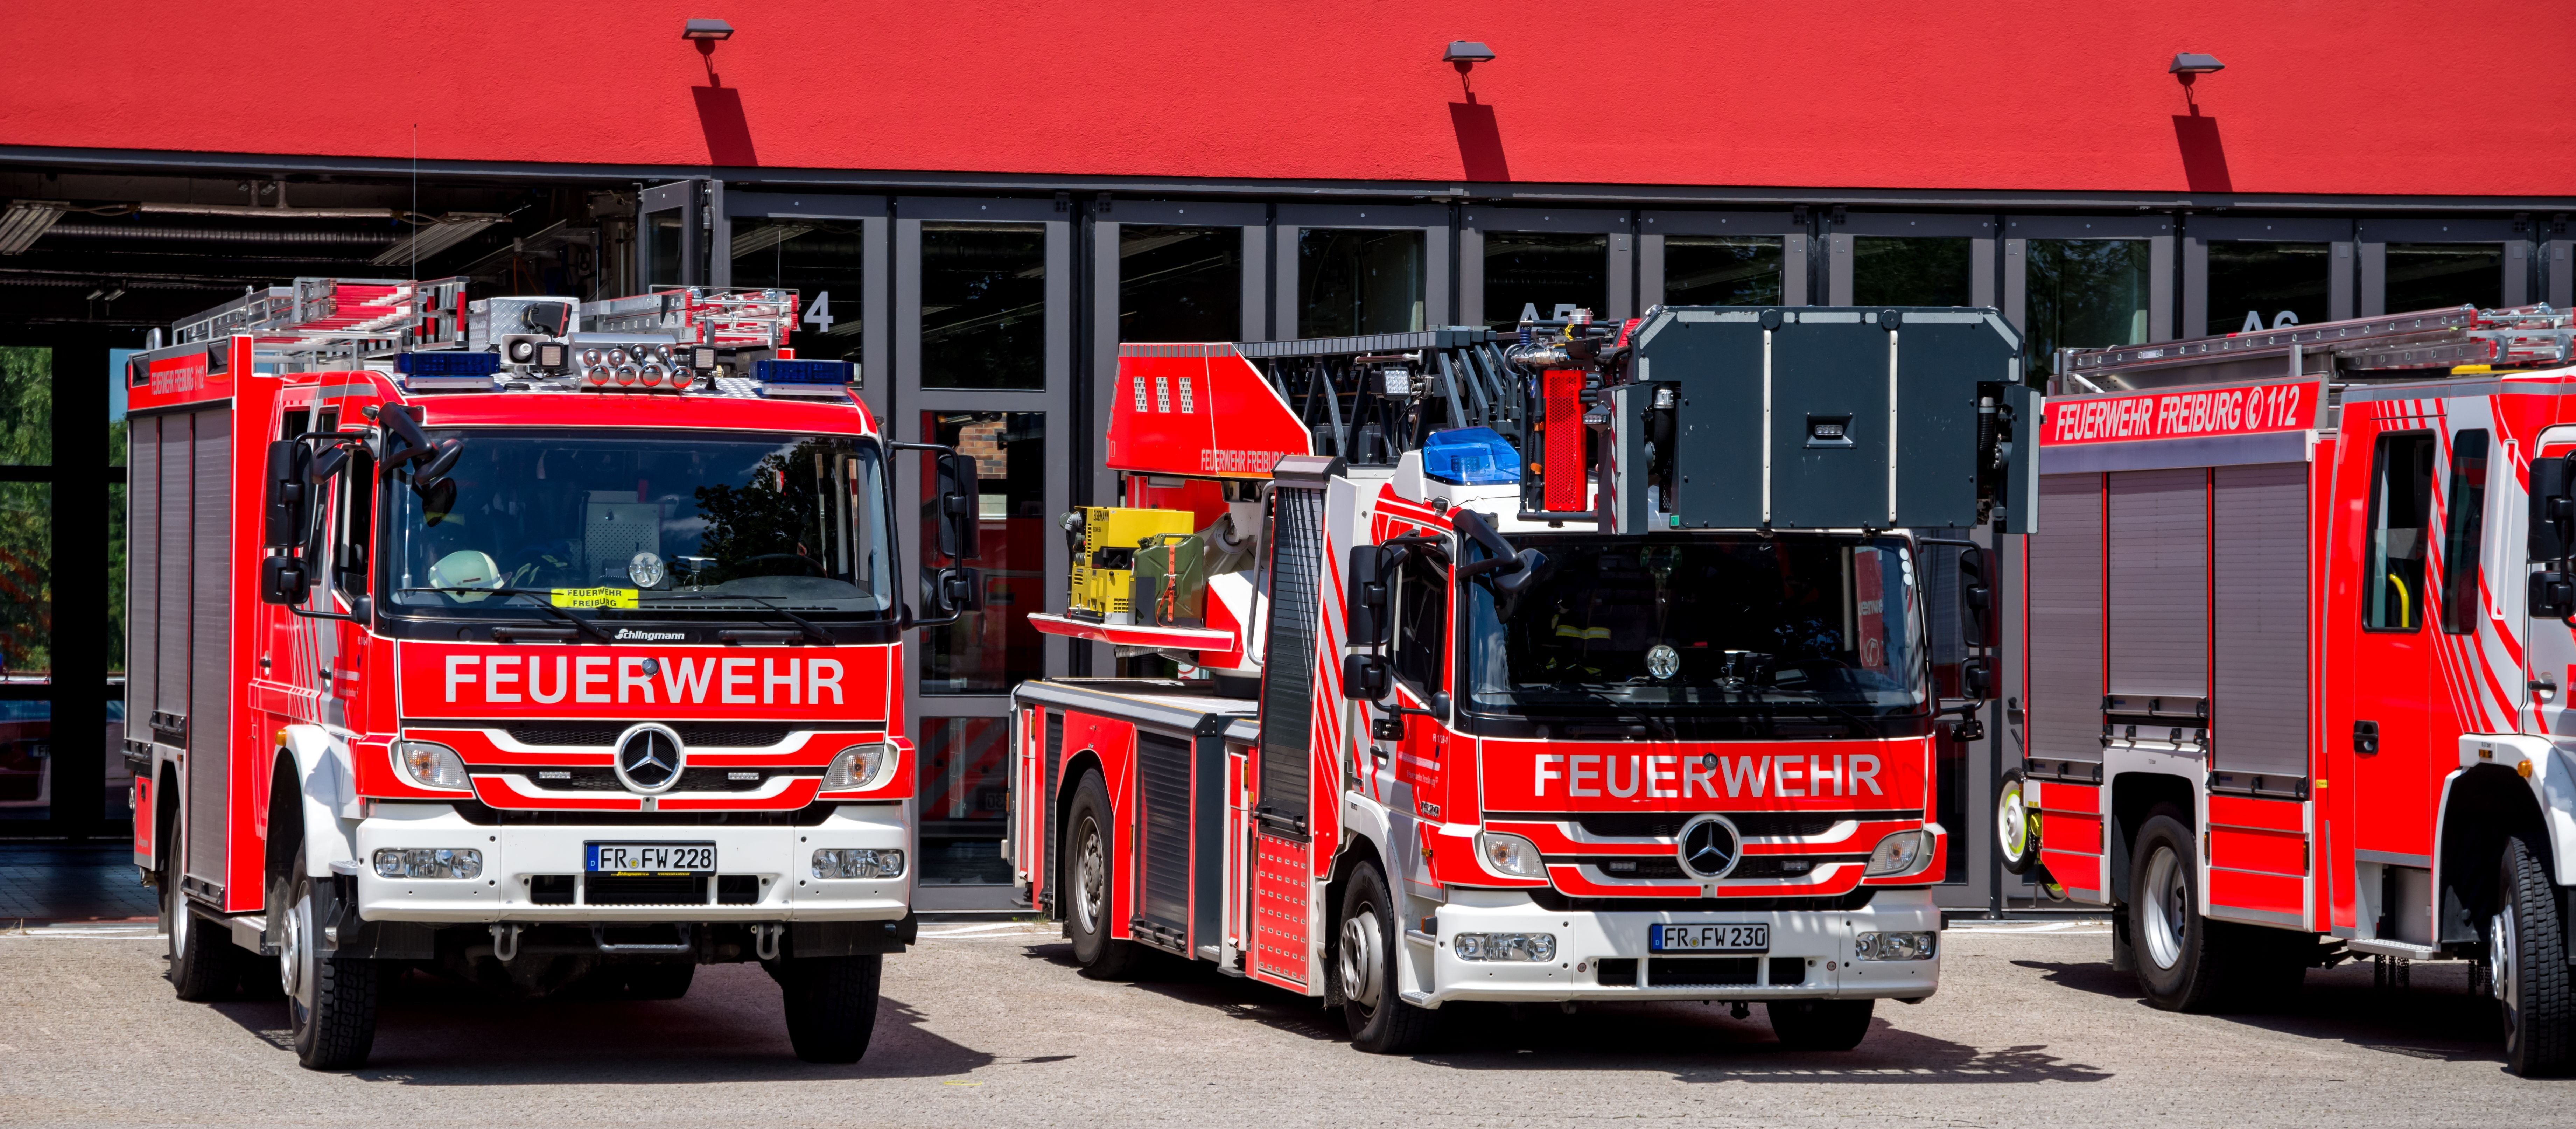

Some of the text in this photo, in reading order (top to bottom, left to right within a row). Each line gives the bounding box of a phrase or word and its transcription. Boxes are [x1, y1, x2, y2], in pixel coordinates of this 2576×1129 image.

[776, 291, 833, 332] 4
[2055, 385, 2300, 441] FEUERWEHR FREIBURG 112
[1201, 449, 1245, 472] FEUERWEHR
[1094, 510, 1109, 521] EISEMANN
[567, 588, 622, 596] FEUERWEHR
[614, 629, 684, 641] Schlingmann
[446, 655, 844, 704] FEUERWEHR
[1433, 734, 1436, 742] FL
[1407, 770, 1436, 788] Feuerwehr Freiburg
[1535, 754, 1883, 798] FEUERWEHR
[601, 848, 627, 868] FR
[642, 848, 668, 868] FW
[673, 849, 711, 868] 228
[1665, 928, 1688, 947] FR
[1702, 928, 1726, 946] FW
[1731, 928, 1765, 946] 230
